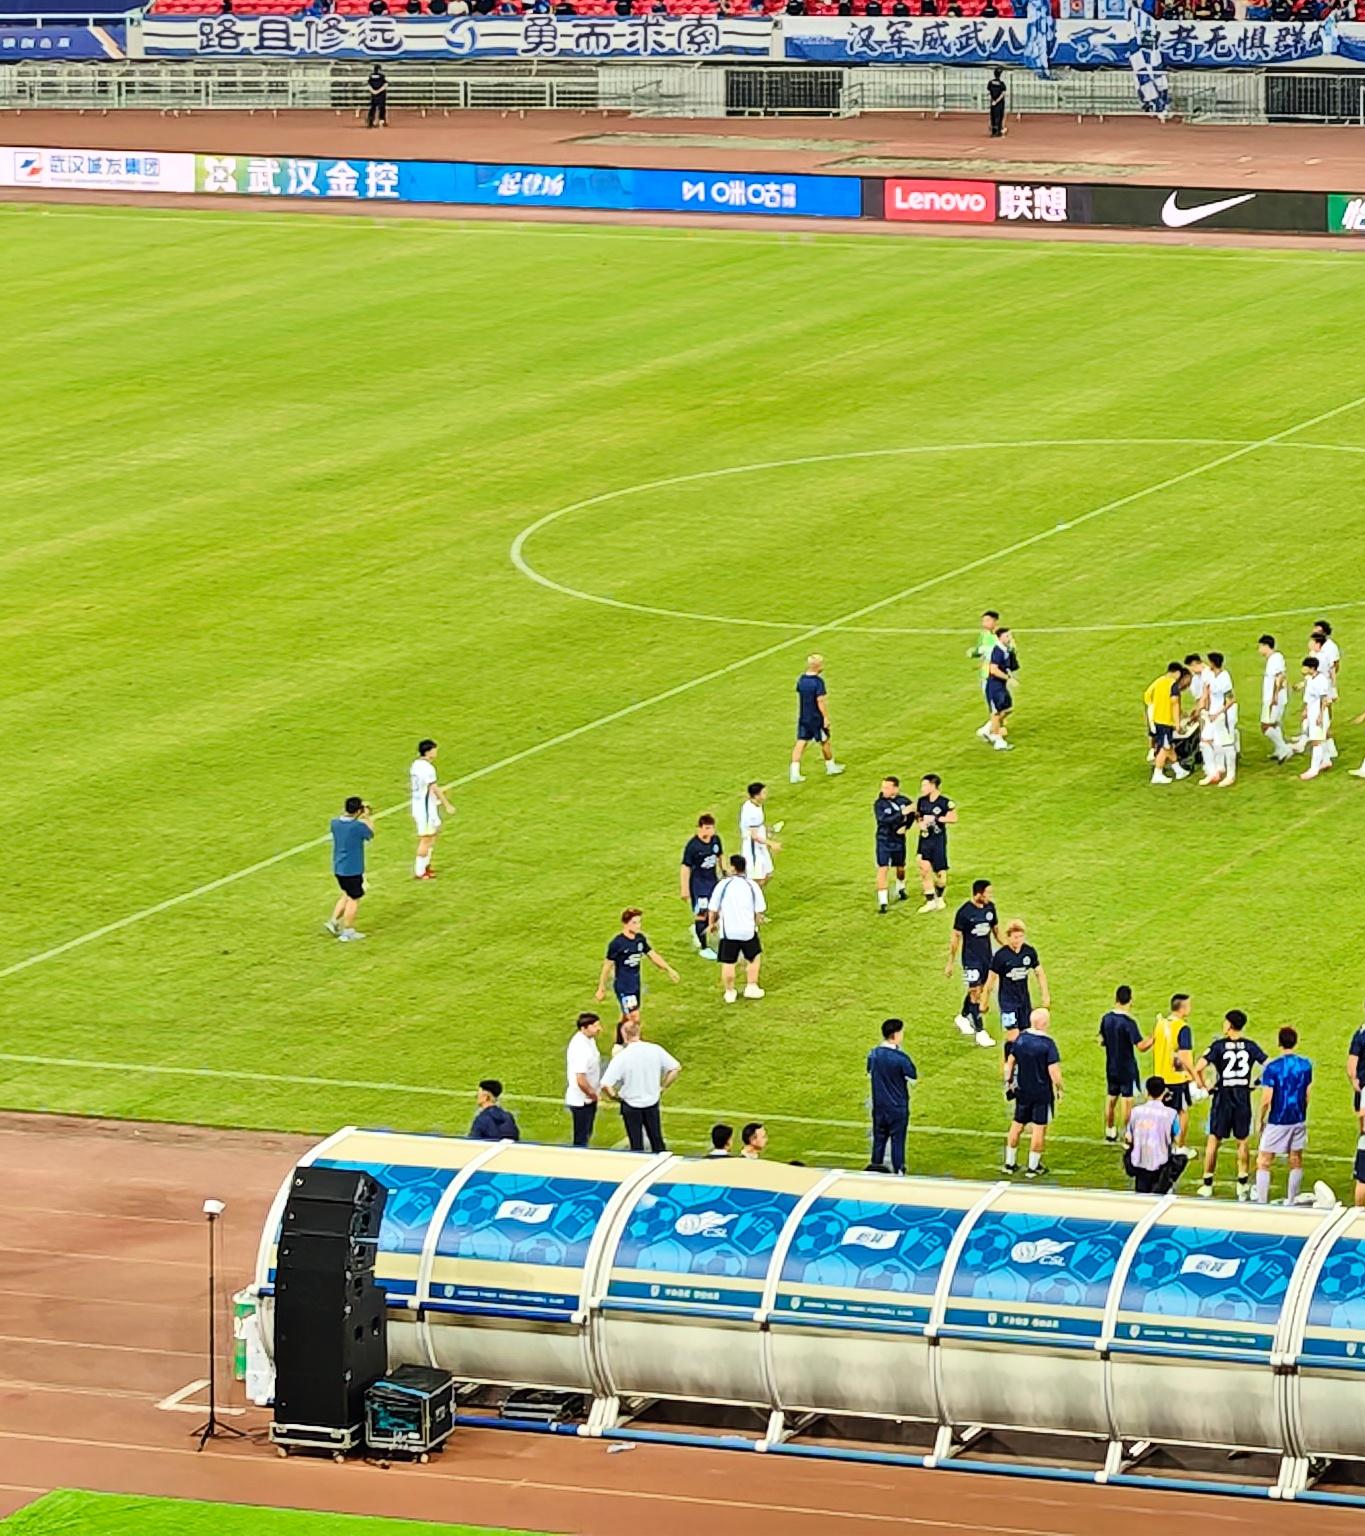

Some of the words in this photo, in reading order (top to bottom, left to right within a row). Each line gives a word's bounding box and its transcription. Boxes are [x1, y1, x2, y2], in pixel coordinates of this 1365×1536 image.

[197, 16, 404, 55] 路且修远
[517, 14, 721, 55] 勇而求索
[246, 158, 401, 198] 武汉金控
[894, 186, 987, 213] Lenovo
[999, 184, 1068, 222] 联想
[1222, 1050, 1251, 1078] 23
